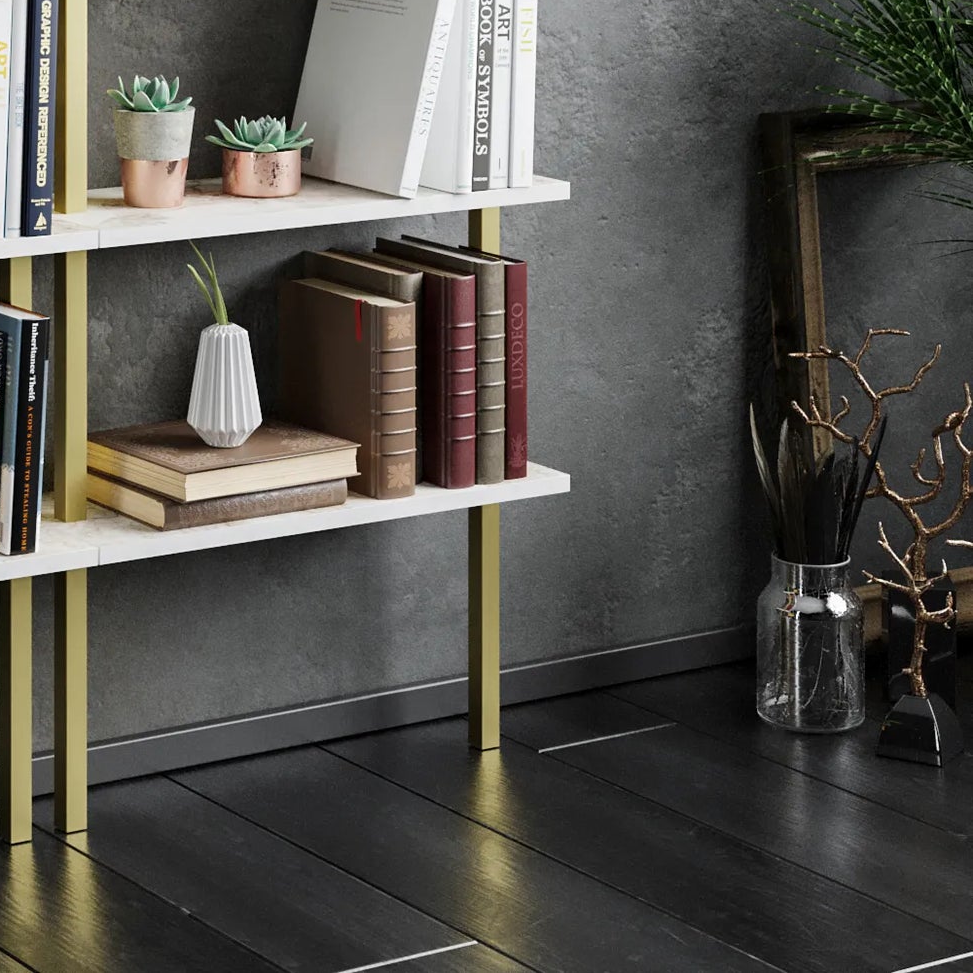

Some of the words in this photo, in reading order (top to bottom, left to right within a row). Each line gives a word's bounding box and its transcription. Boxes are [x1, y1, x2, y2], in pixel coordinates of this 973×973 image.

[39, 0, 52, 56] GRAPHIC
[497, 4, 511, 41] ART
[478, 49, 486, 62] OF
[38, 58, 51, 104] DESIGN
[475, 64, 491, 156] SYMBOLS
[36, 106, 50, 188] REFERENCED
[29, 322, 40, 374] Inheritance
[511, 302, 524, 390] LUXDECO
[24, 469, 31, 481] TO
[22, 483, 30, 524] STEALING
[20, 526, 28, 552] HOME
